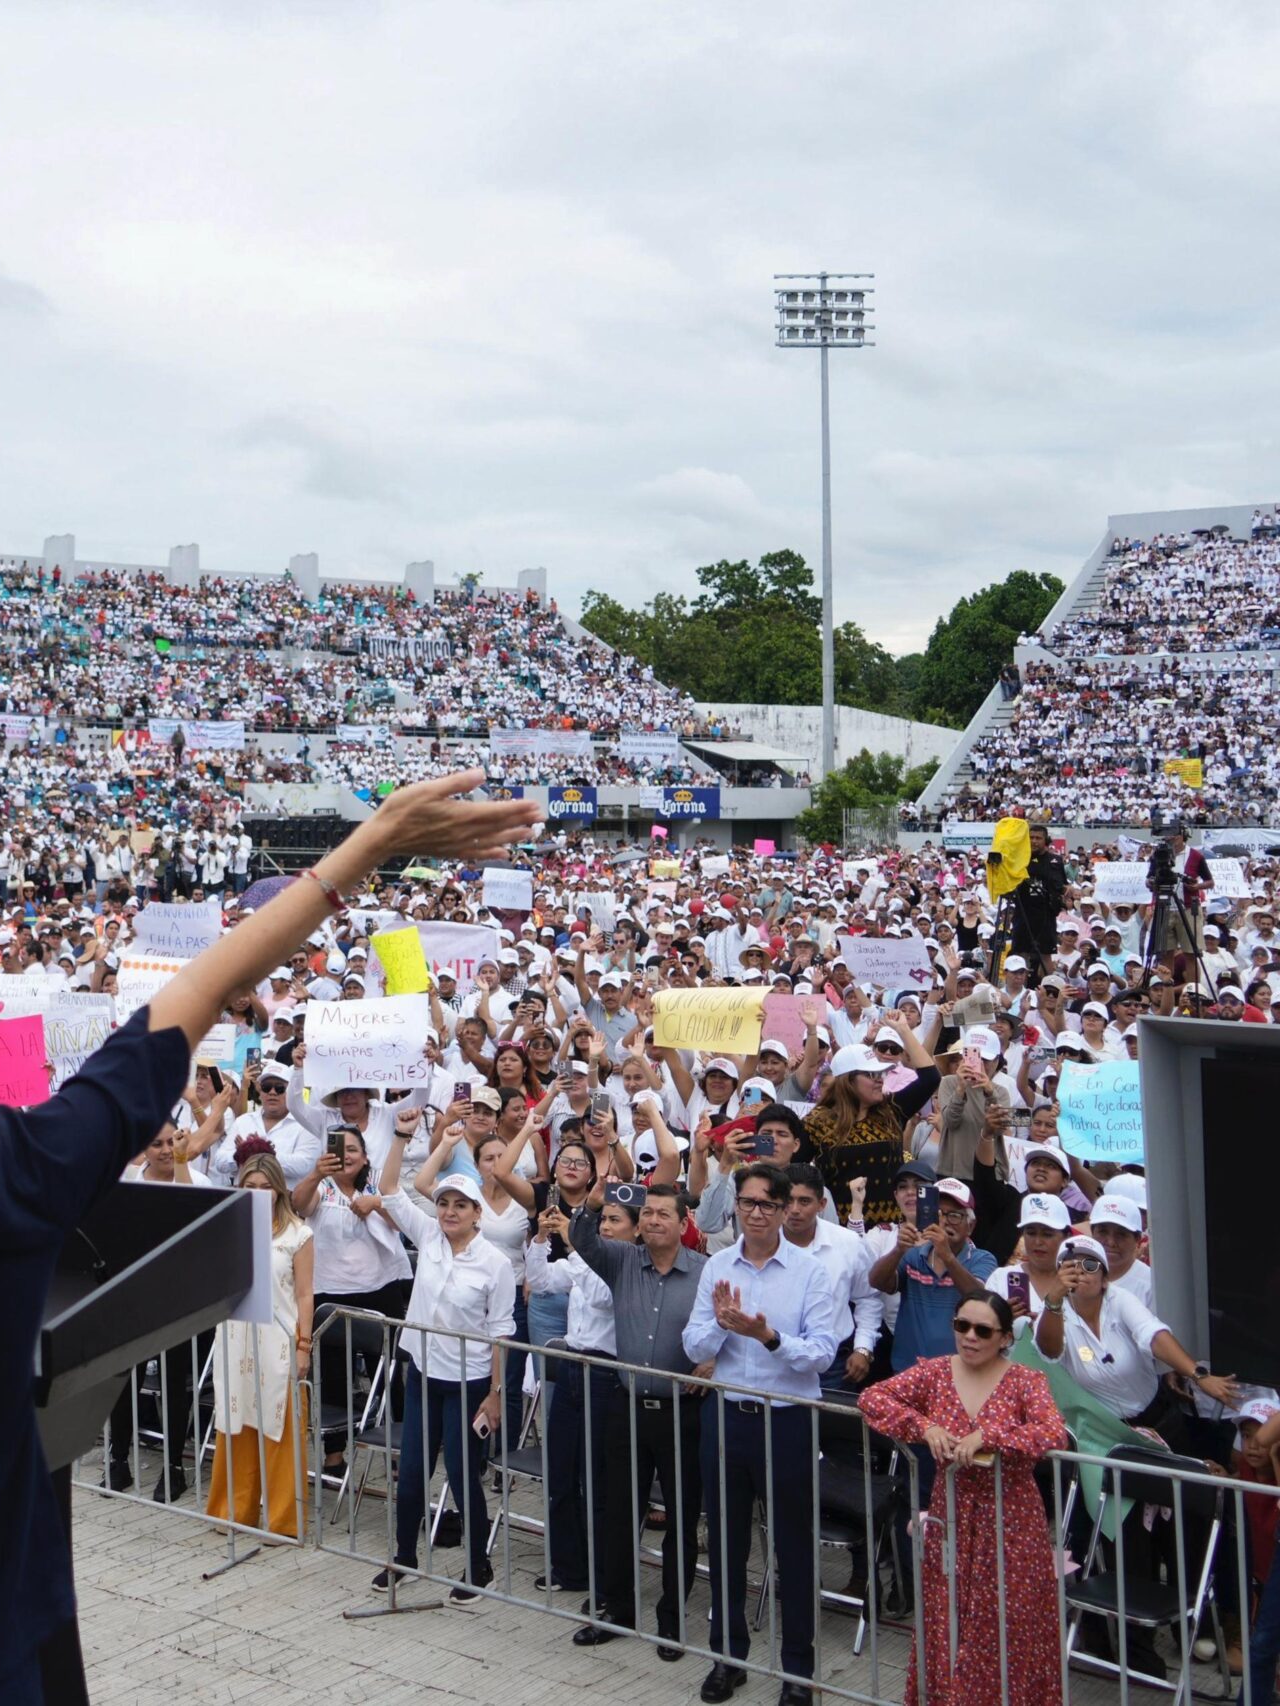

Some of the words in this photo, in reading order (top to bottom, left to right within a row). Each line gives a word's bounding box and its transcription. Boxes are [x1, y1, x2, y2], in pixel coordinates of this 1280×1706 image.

[414, 641, 448, 660] CHICO
[549, 799, 594, 818] Corona
[659, 800, 707, 818] Corona
[144, 907, 210, 919] BIENVENIDA
[20, 1031, 40, 1057] LA
[338, 1060, 426, 1083] PRESENTES
[1086, 1077, 1103, 1090] En
[1069, 1114, 1100, 1131] Patria
